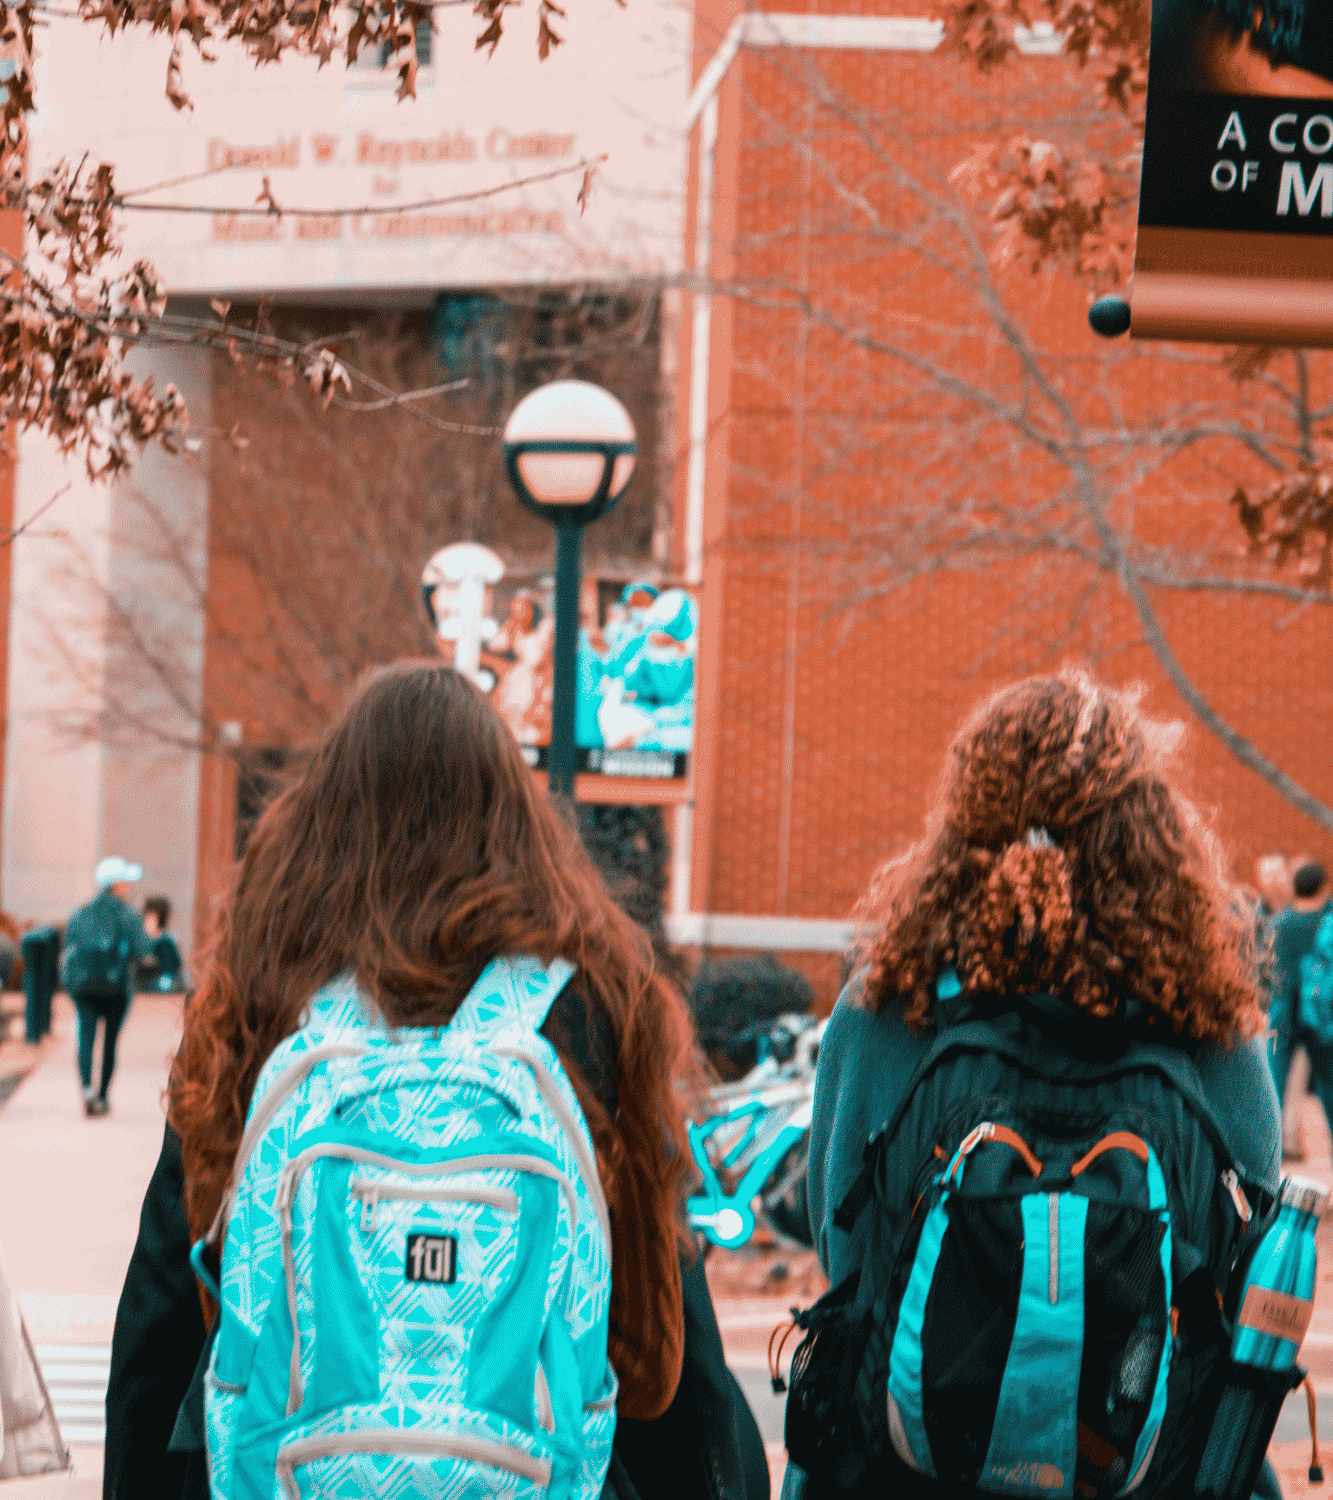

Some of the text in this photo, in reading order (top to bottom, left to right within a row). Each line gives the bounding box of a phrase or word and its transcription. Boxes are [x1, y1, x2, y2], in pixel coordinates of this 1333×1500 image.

[207, 135, 301, 171] Donald
[356, 131, 477, 171] Reynolds
[487, 128, 576, 161] Center
[1217, 111, 1333, 155] A CO
[1211, 159, 1333, 218] OF M
[212, 202, 566, 243] Music and Communication
